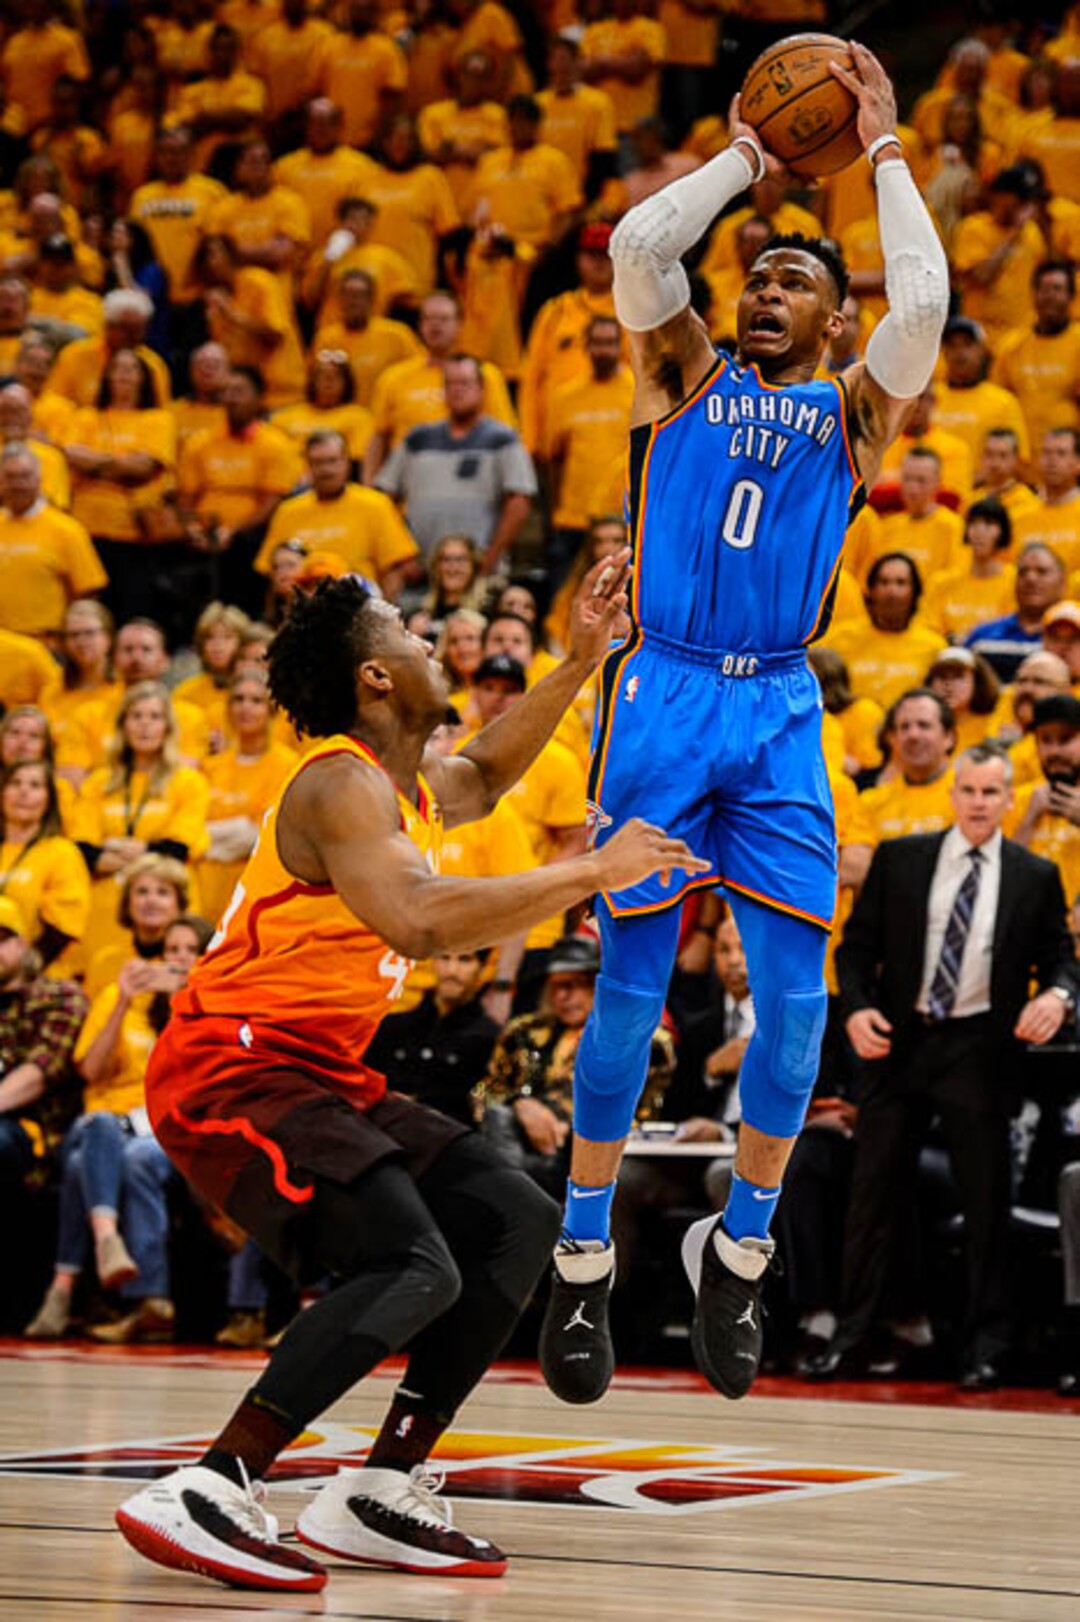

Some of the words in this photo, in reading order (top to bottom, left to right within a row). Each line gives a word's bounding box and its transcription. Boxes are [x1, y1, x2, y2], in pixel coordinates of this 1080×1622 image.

[707, 393, 836, 446] OKAHOMA
[729, 425, 789, 468] CITY
[722, 479, 764, 549] 0
[379, 949, 416, 1001] 4
